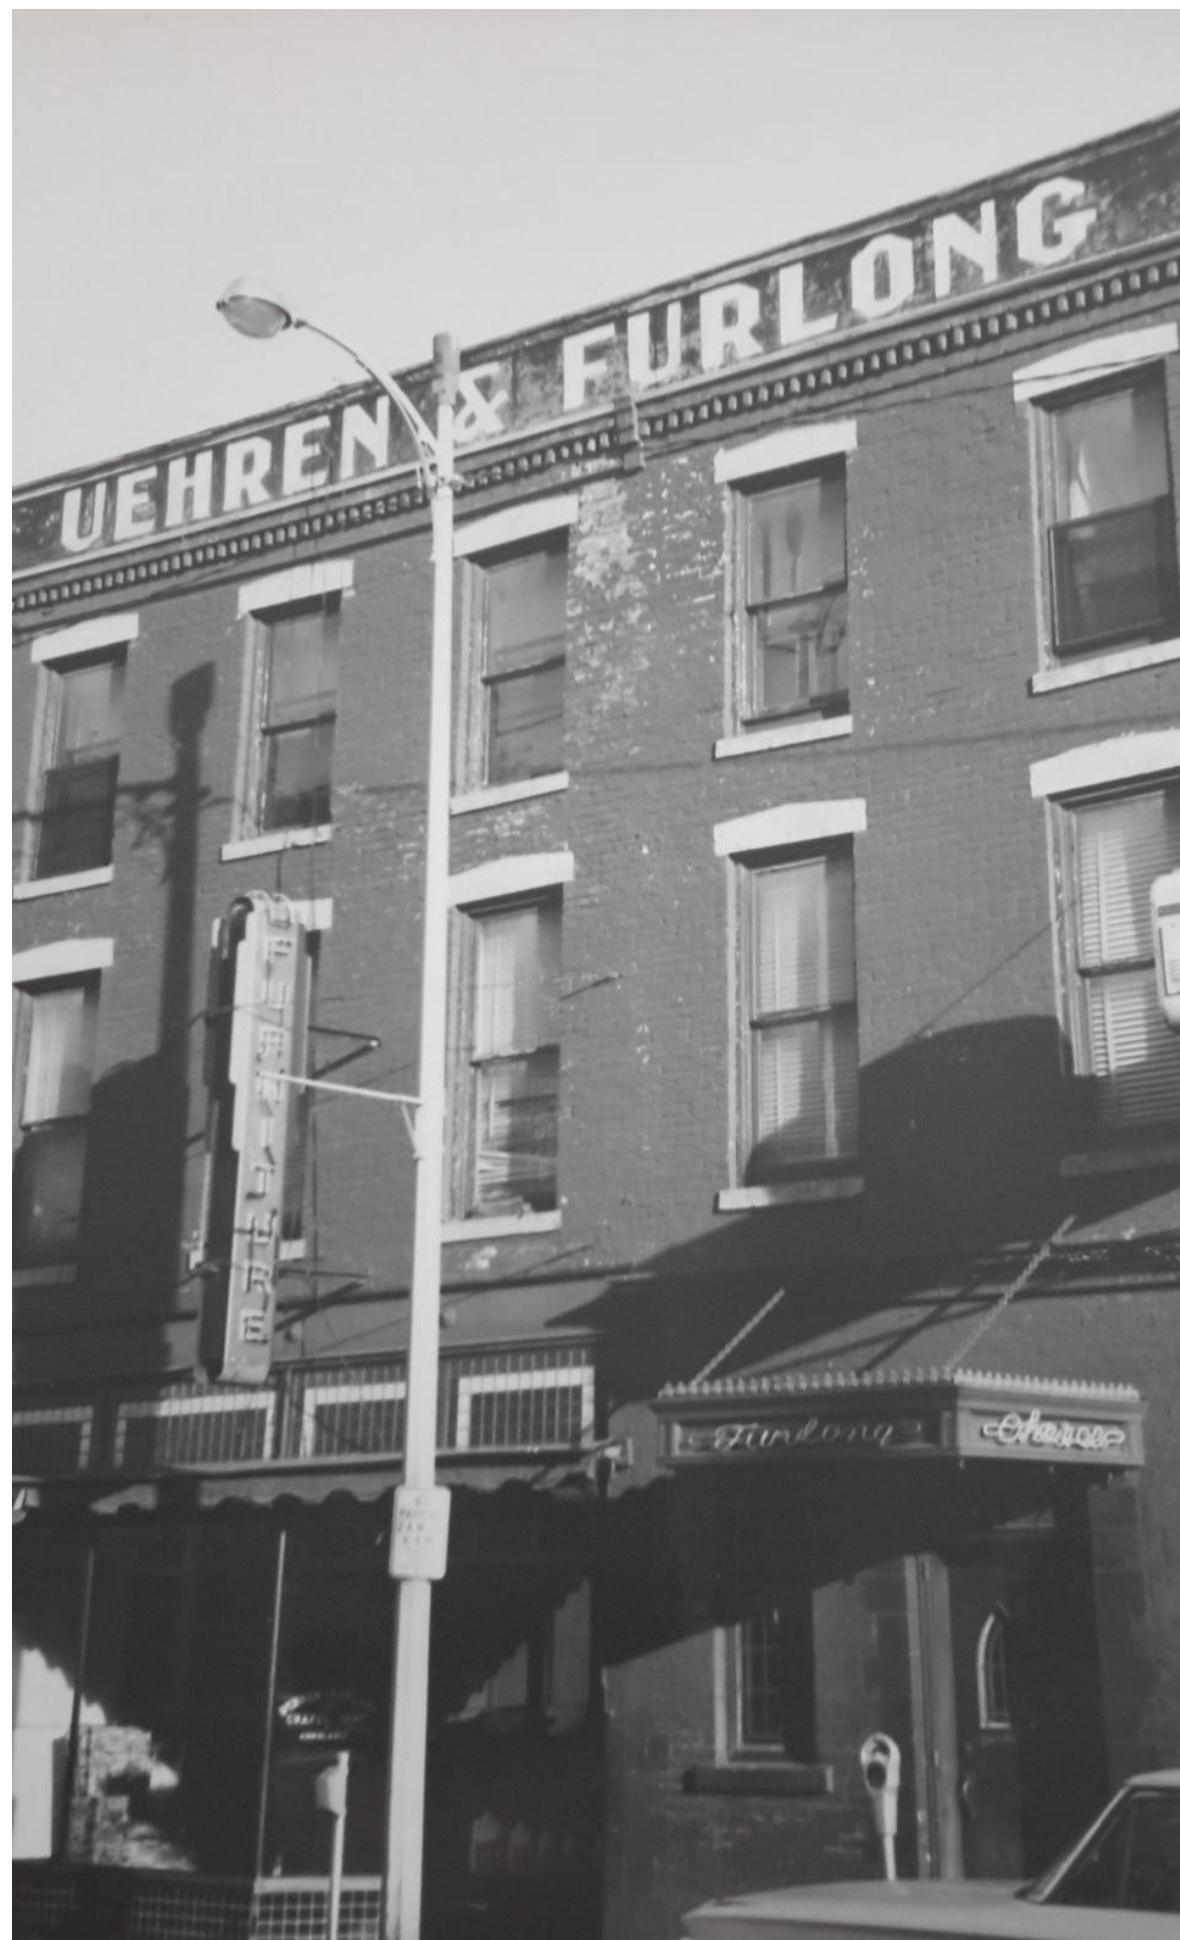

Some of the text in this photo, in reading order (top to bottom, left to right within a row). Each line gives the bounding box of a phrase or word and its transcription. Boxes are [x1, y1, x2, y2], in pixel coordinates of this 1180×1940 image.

[61, 176, 1098, 552] UEHREN & FURLONG
[713, 1416, 895, 1451] Furlong
